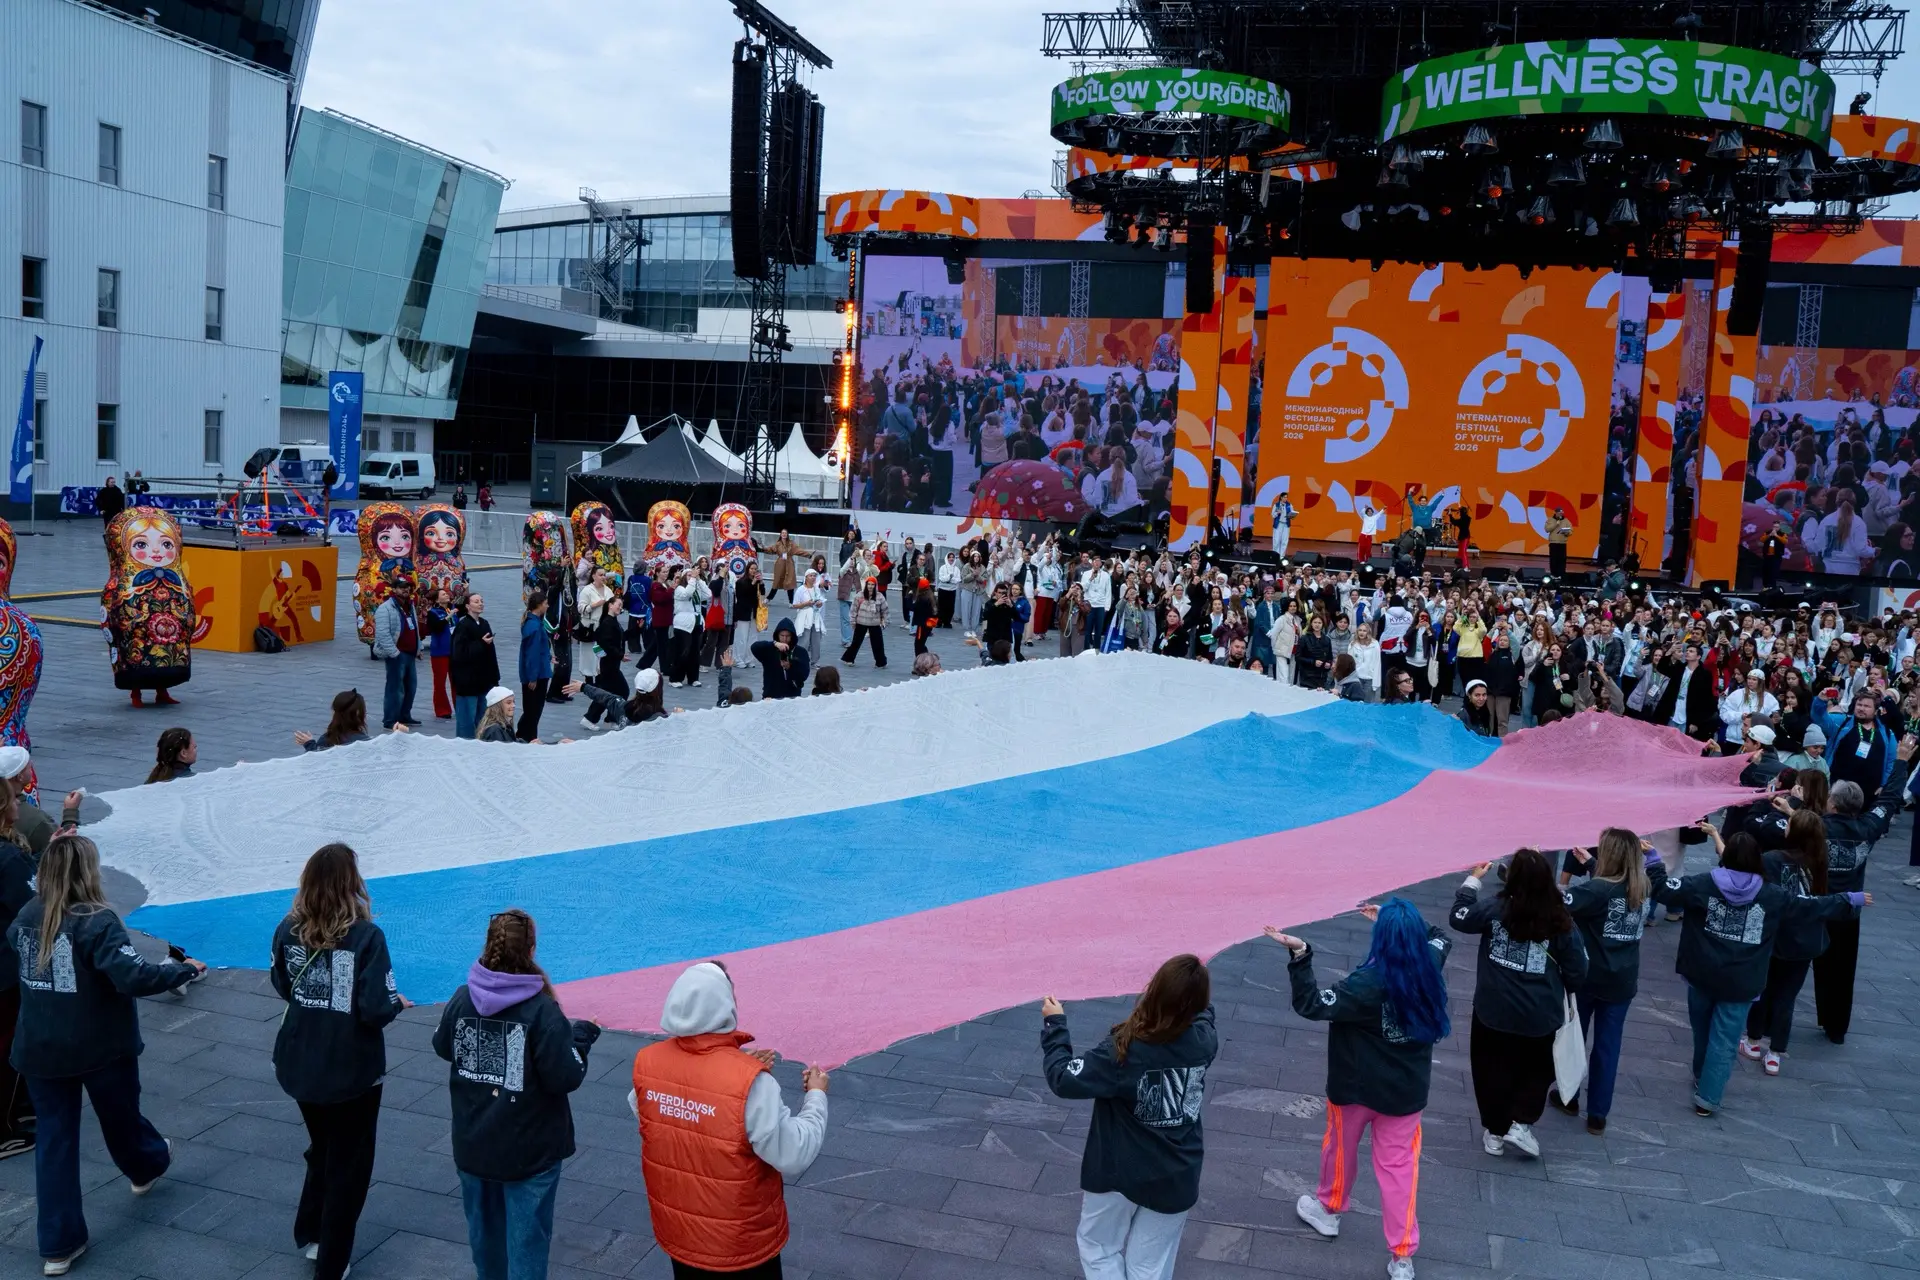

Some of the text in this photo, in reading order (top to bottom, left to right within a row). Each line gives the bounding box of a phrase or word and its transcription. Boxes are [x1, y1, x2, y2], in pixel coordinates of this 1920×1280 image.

[1425, 56, 1820, 122] WELLNESS TRACK
[1067, 79, 1285, 117] FOLLOW YOUR DREAM
[1285, 404, 1364, 415] МЕЖДУНАРОДНЫЙ
[1284, 414, 1336, 423] ФЕСТИВАЛЬ
[1456, 413, 1532, 425] INTERNATIONAL
[1283, 423, 1334, 432] МОЛОДЁЖИ
[1455, 423, 1500, 433] FESTIVAL
[1283, 432, 1304, 440] 2026
[1455, 433, 1504, 443] OF YOUTH
[1454, 443, 1478, 452] 2026
[458, 1069, 503, 1083] ОРЕНБУРЖЬЕ
[646, 1090, 716, 1117] SVERDLOVSK
[660, 1105, 699, 1123] REGION
